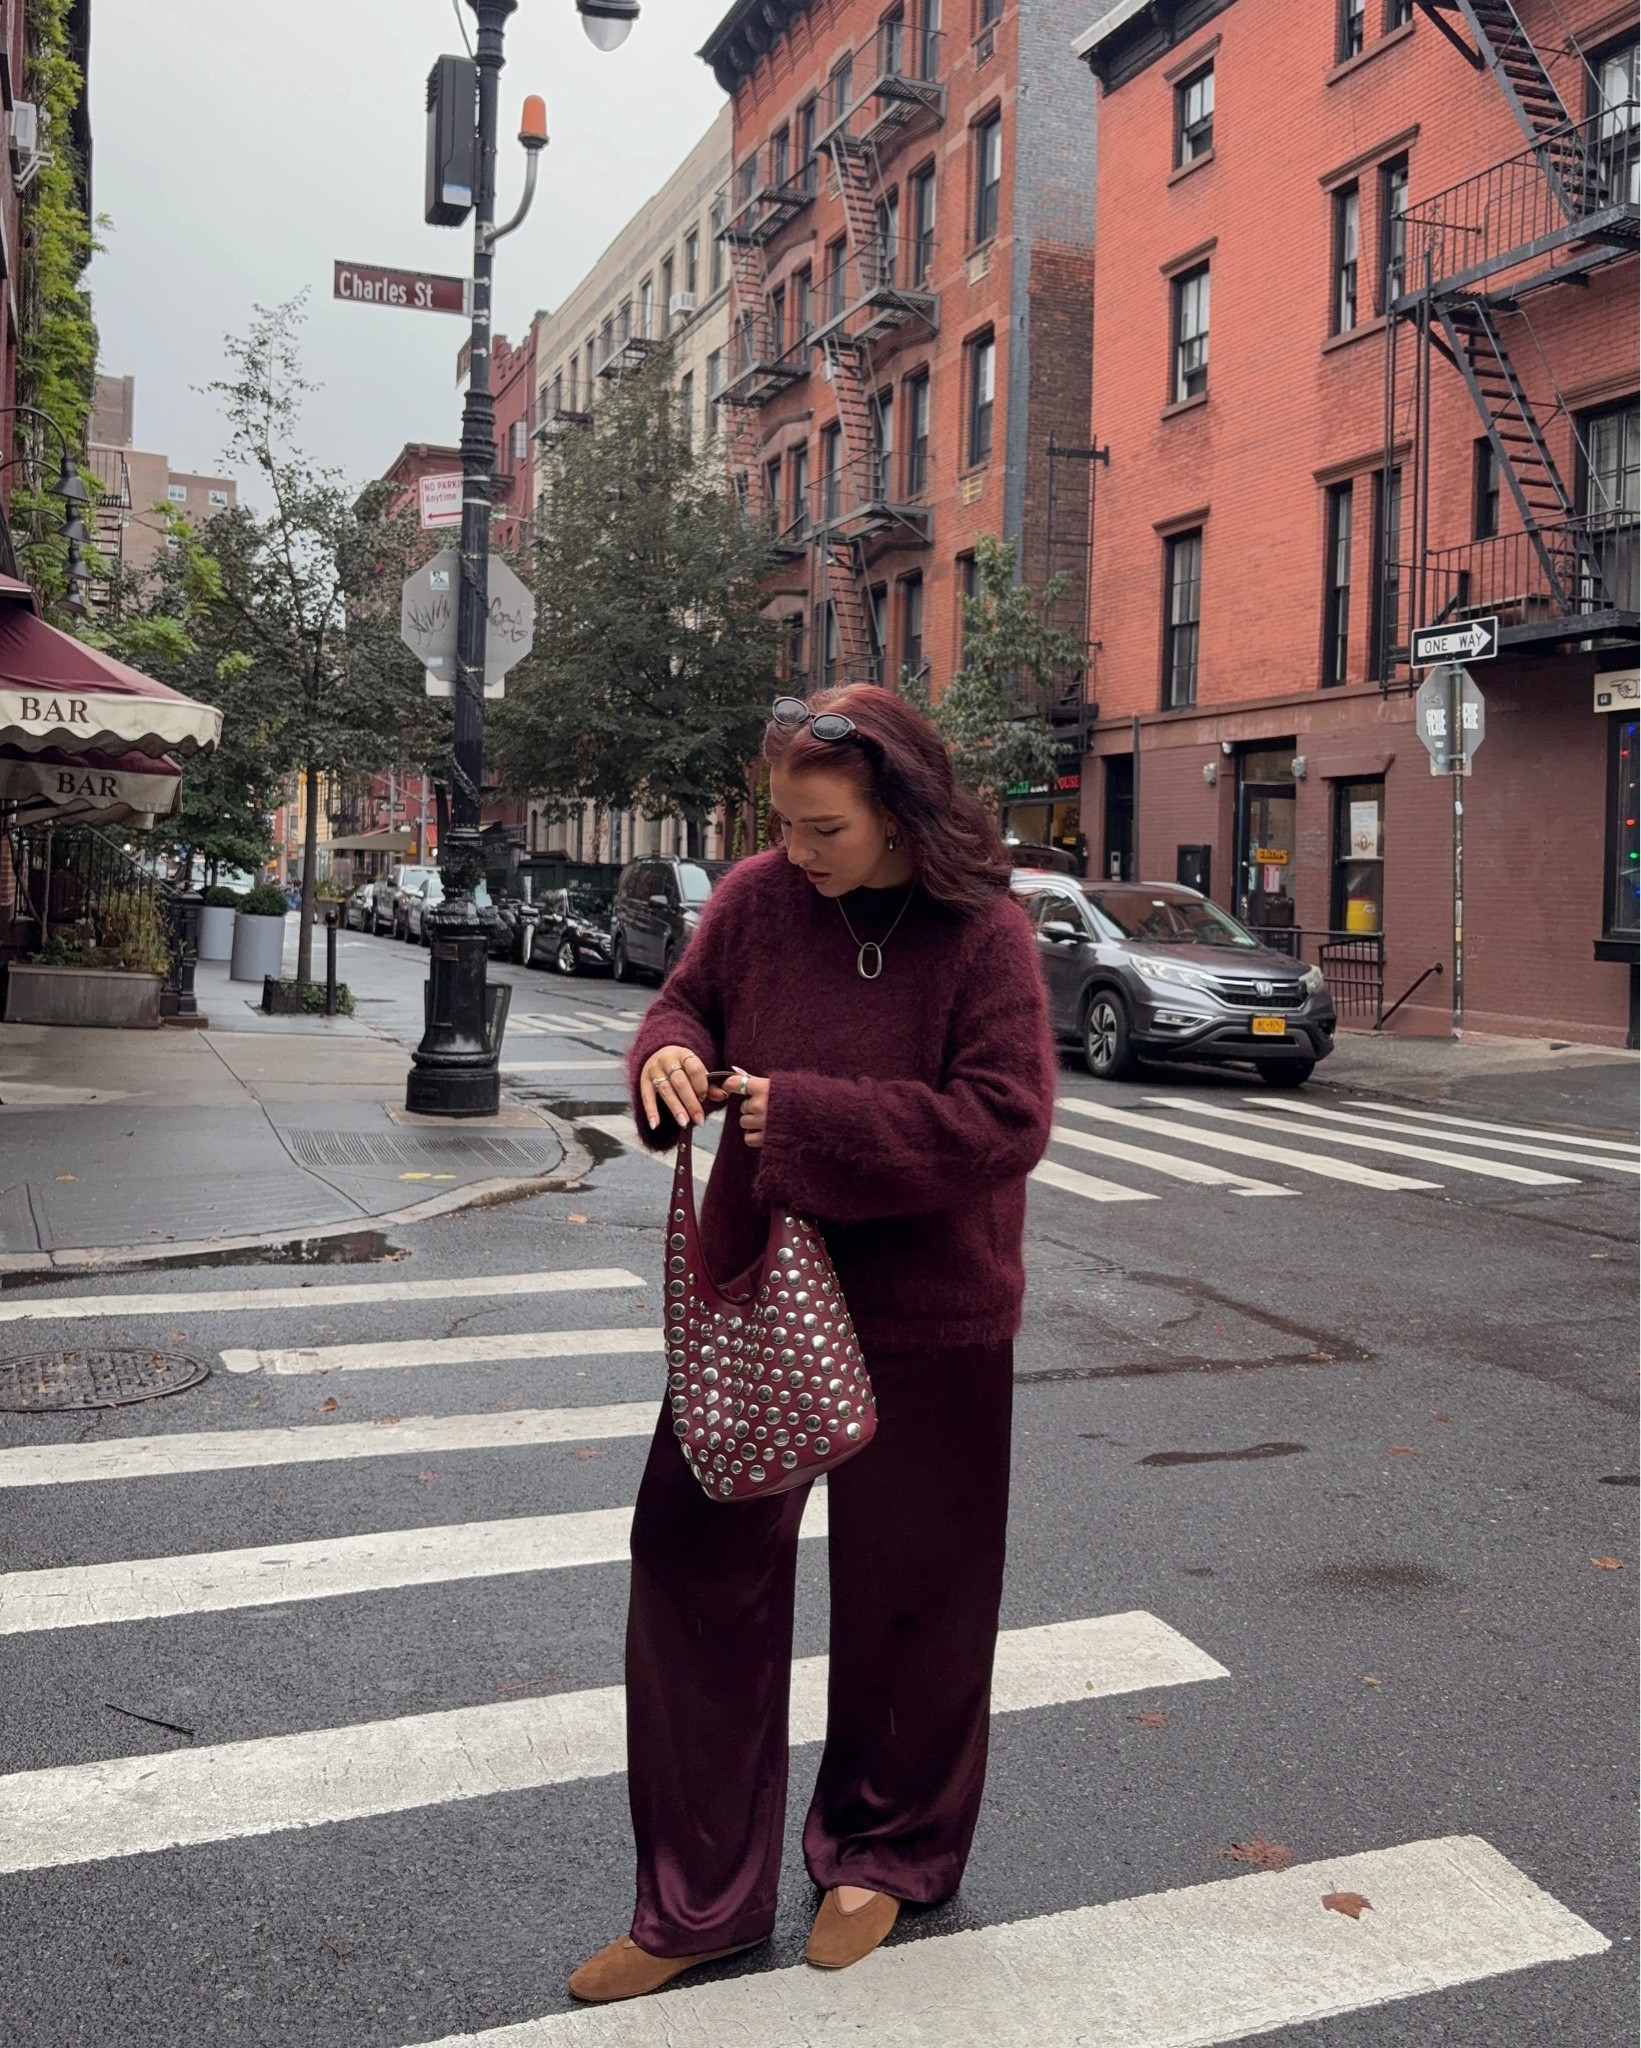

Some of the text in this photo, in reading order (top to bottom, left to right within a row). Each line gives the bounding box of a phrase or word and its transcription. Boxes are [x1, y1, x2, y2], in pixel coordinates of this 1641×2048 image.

[339, 270, 434, 308] Charles St
[424, 482, 436, 493] NO
[425, 492, 458, 504] Anytime
[1424, 631, 1484, 655] ONE WAY
[19, 696, 91, 724] BAR
[56, 771, 119, 798] BAR
